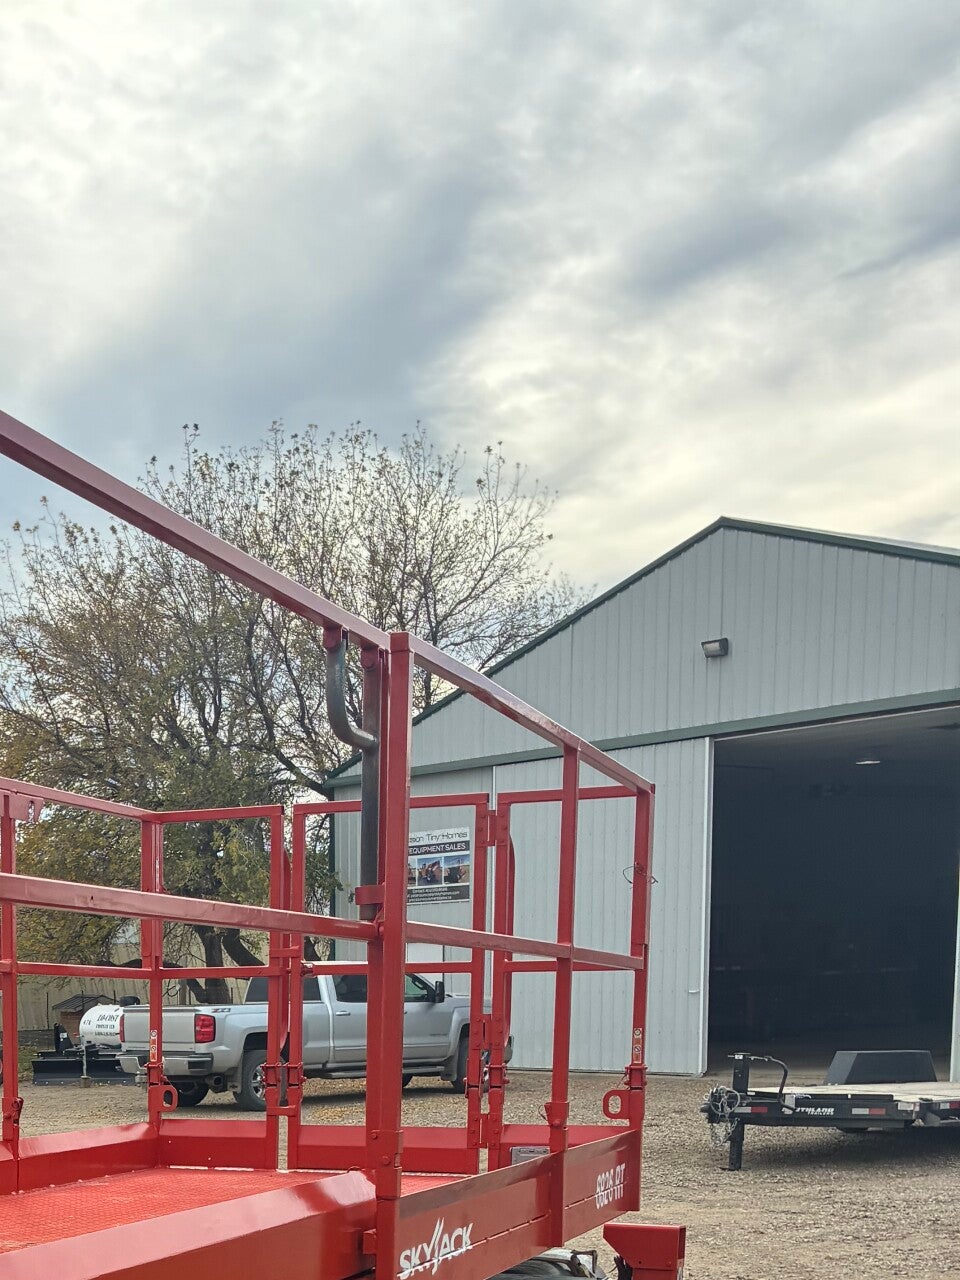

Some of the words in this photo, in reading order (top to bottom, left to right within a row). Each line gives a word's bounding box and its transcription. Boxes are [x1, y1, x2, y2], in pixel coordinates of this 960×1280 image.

[426, 832, 441, 842] Tiny
[442, 831, 468, 840] Homes
[409, 845, 444, 854] EQUIPMENT
[445, 843, 466, 851] SALES
[398, 1216, 473, 1280] SKYJACK
